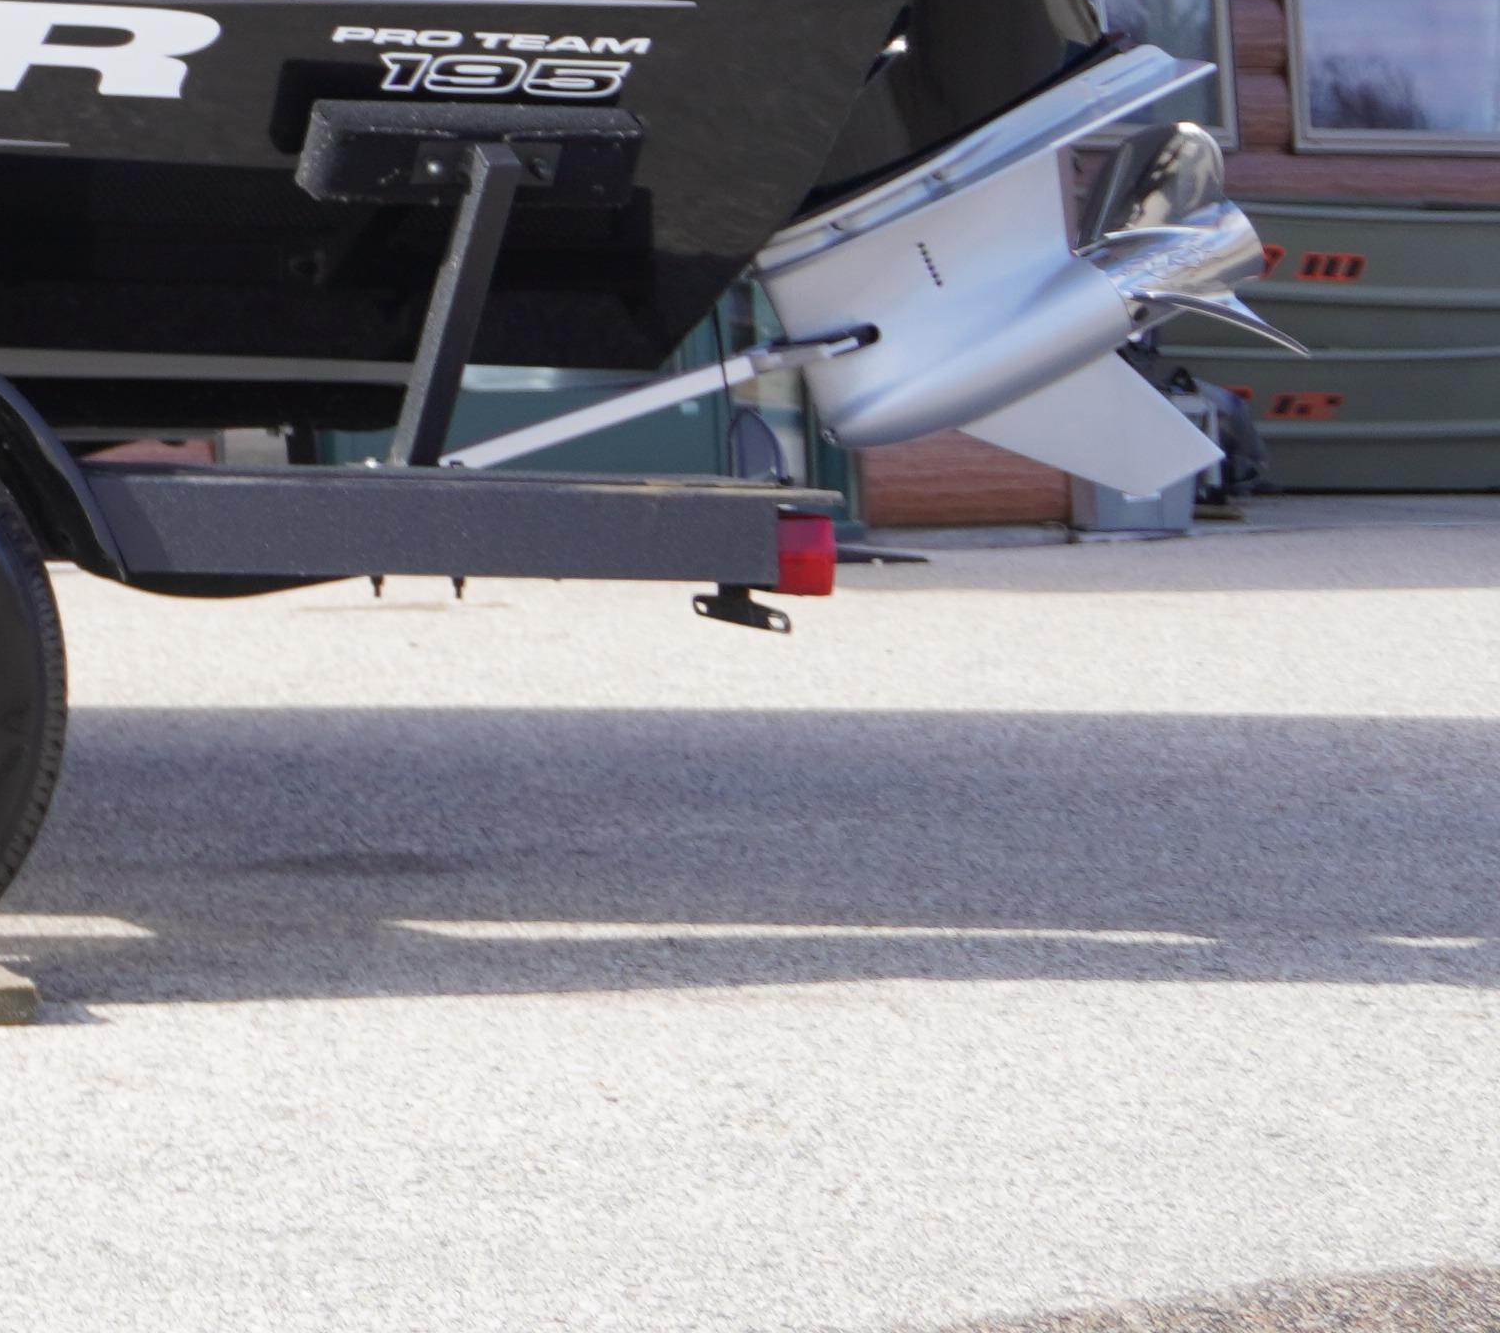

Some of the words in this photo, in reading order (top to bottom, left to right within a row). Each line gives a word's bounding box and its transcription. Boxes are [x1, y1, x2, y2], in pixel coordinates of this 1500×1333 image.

[331, 25, 464, 48] PRO
[473, 31, 653, 55] TEAM
[380, 51, 632, 100] 195
